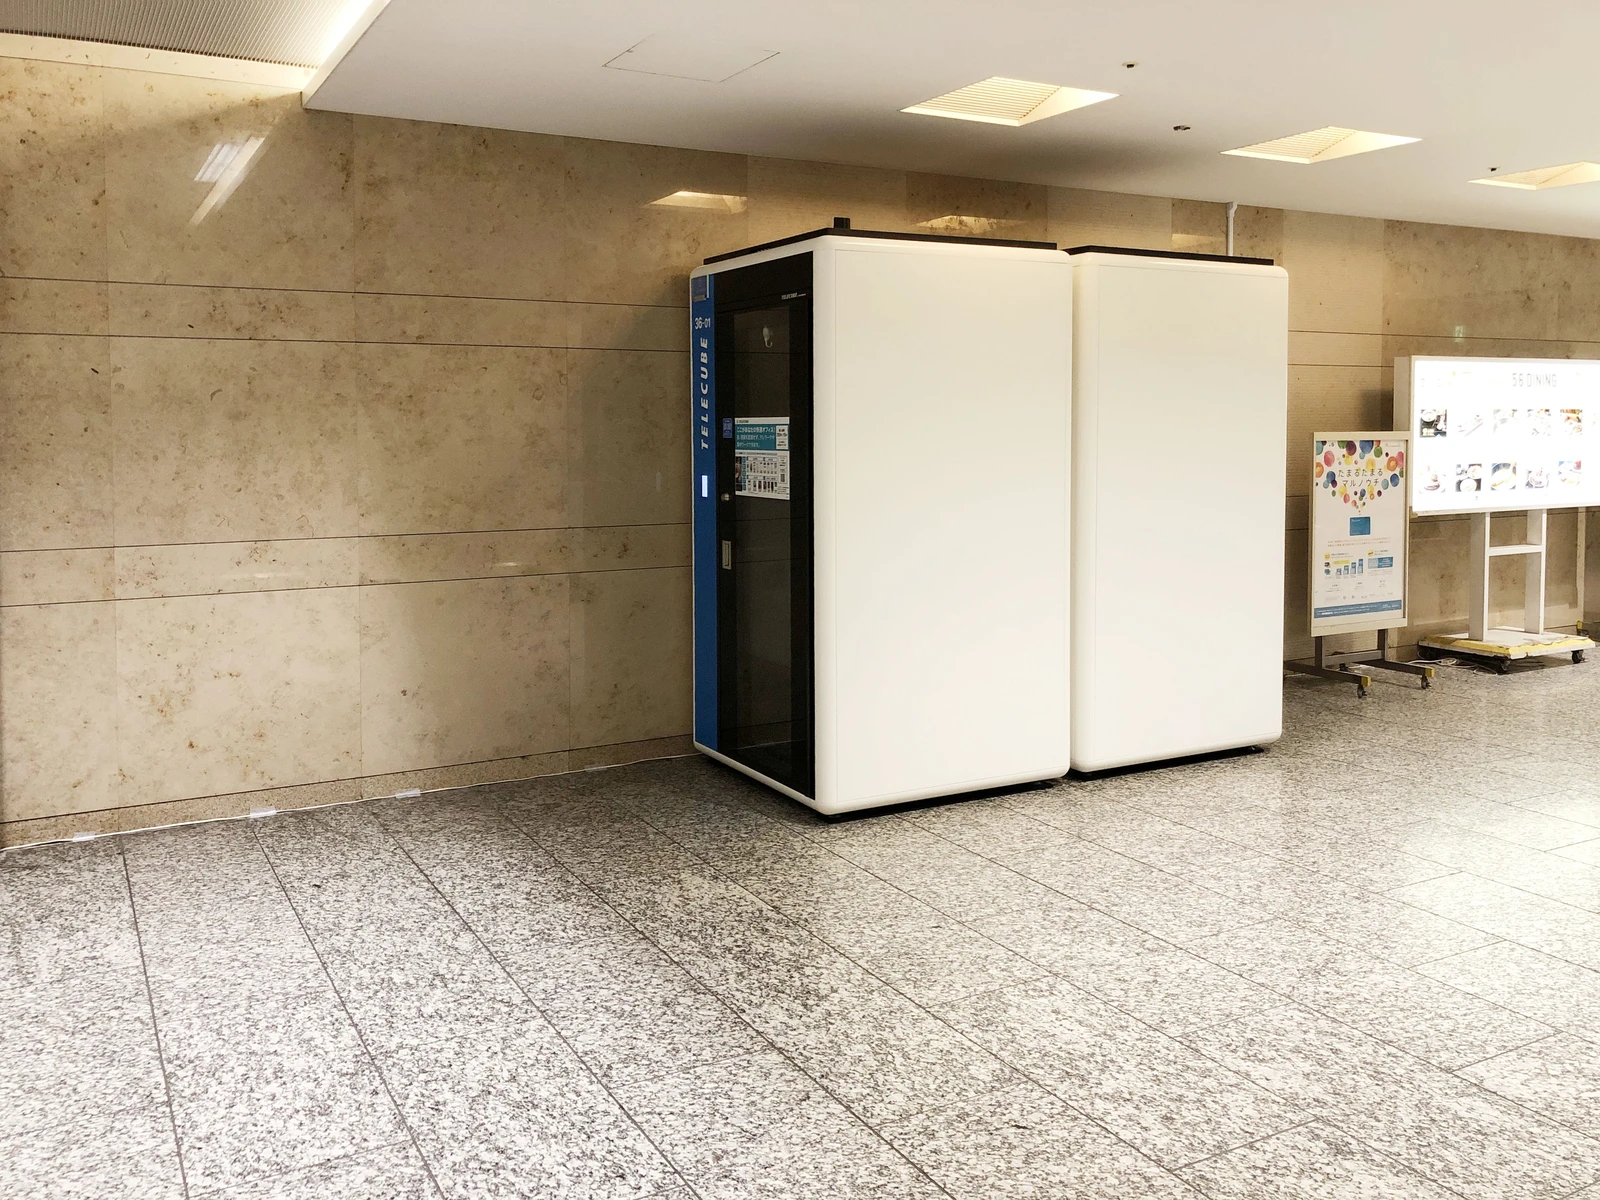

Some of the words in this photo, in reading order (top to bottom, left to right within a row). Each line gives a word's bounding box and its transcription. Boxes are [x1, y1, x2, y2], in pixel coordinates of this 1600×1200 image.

[695, 317, 711, 330] 36-01
[1512, 372, 1524, 387] 56
[1526, 373, 1557, 388] DINING
[700, 337, 709, 450] TELECUBE
[1338, 468, 1383, 478] たまるたまる
[1342, 478, 1380, 488] マルノウチ
